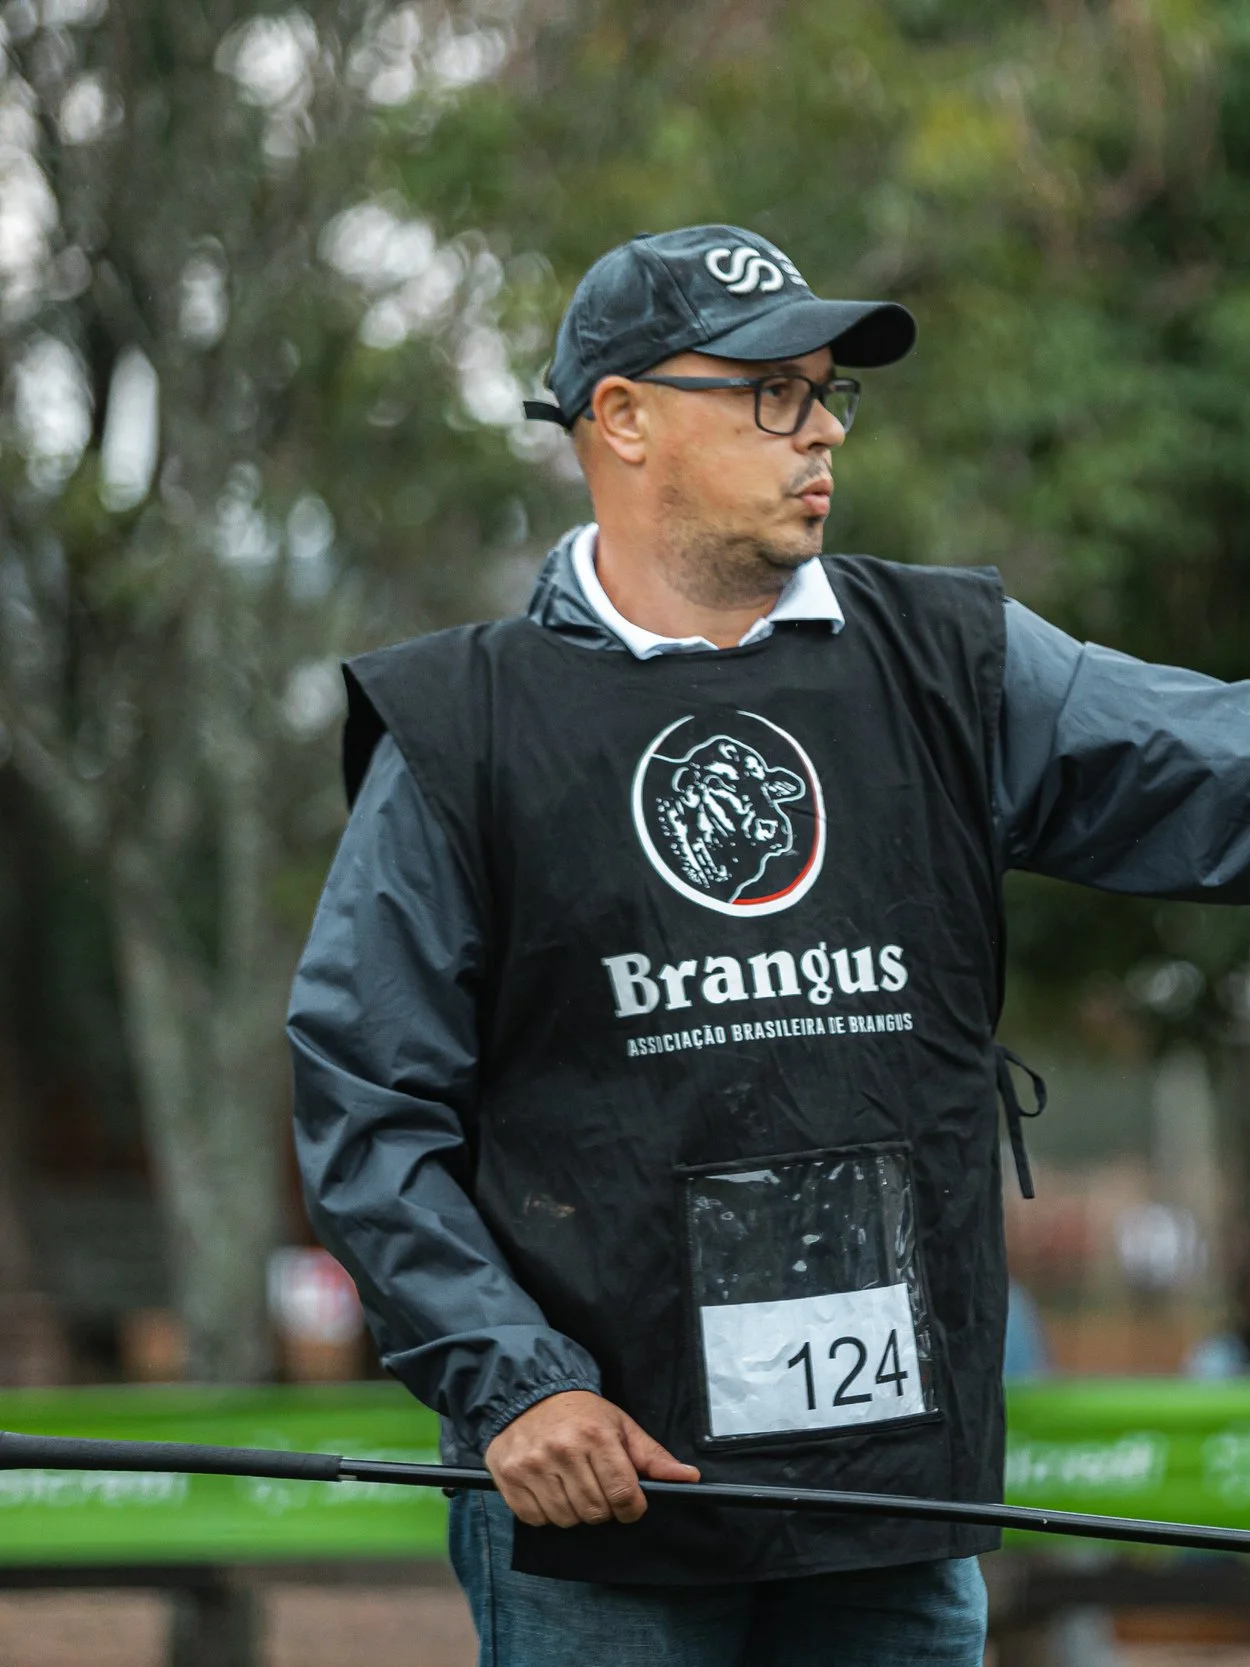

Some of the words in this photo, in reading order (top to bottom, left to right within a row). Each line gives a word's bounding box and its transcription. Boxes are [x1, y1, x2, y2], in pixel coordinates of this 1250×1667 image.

[602, 942, 908, 1017] Brangus
[627, 1025, 726, 1057] ASSOCIAÇÃO
[731, 1017, 826, 1042] BRASILEIRA
[828, 1016, 846, 1034] DE
[848, 1013, 913, 1033] BRANGUS
[787, 1328, 908, 1410] 124
